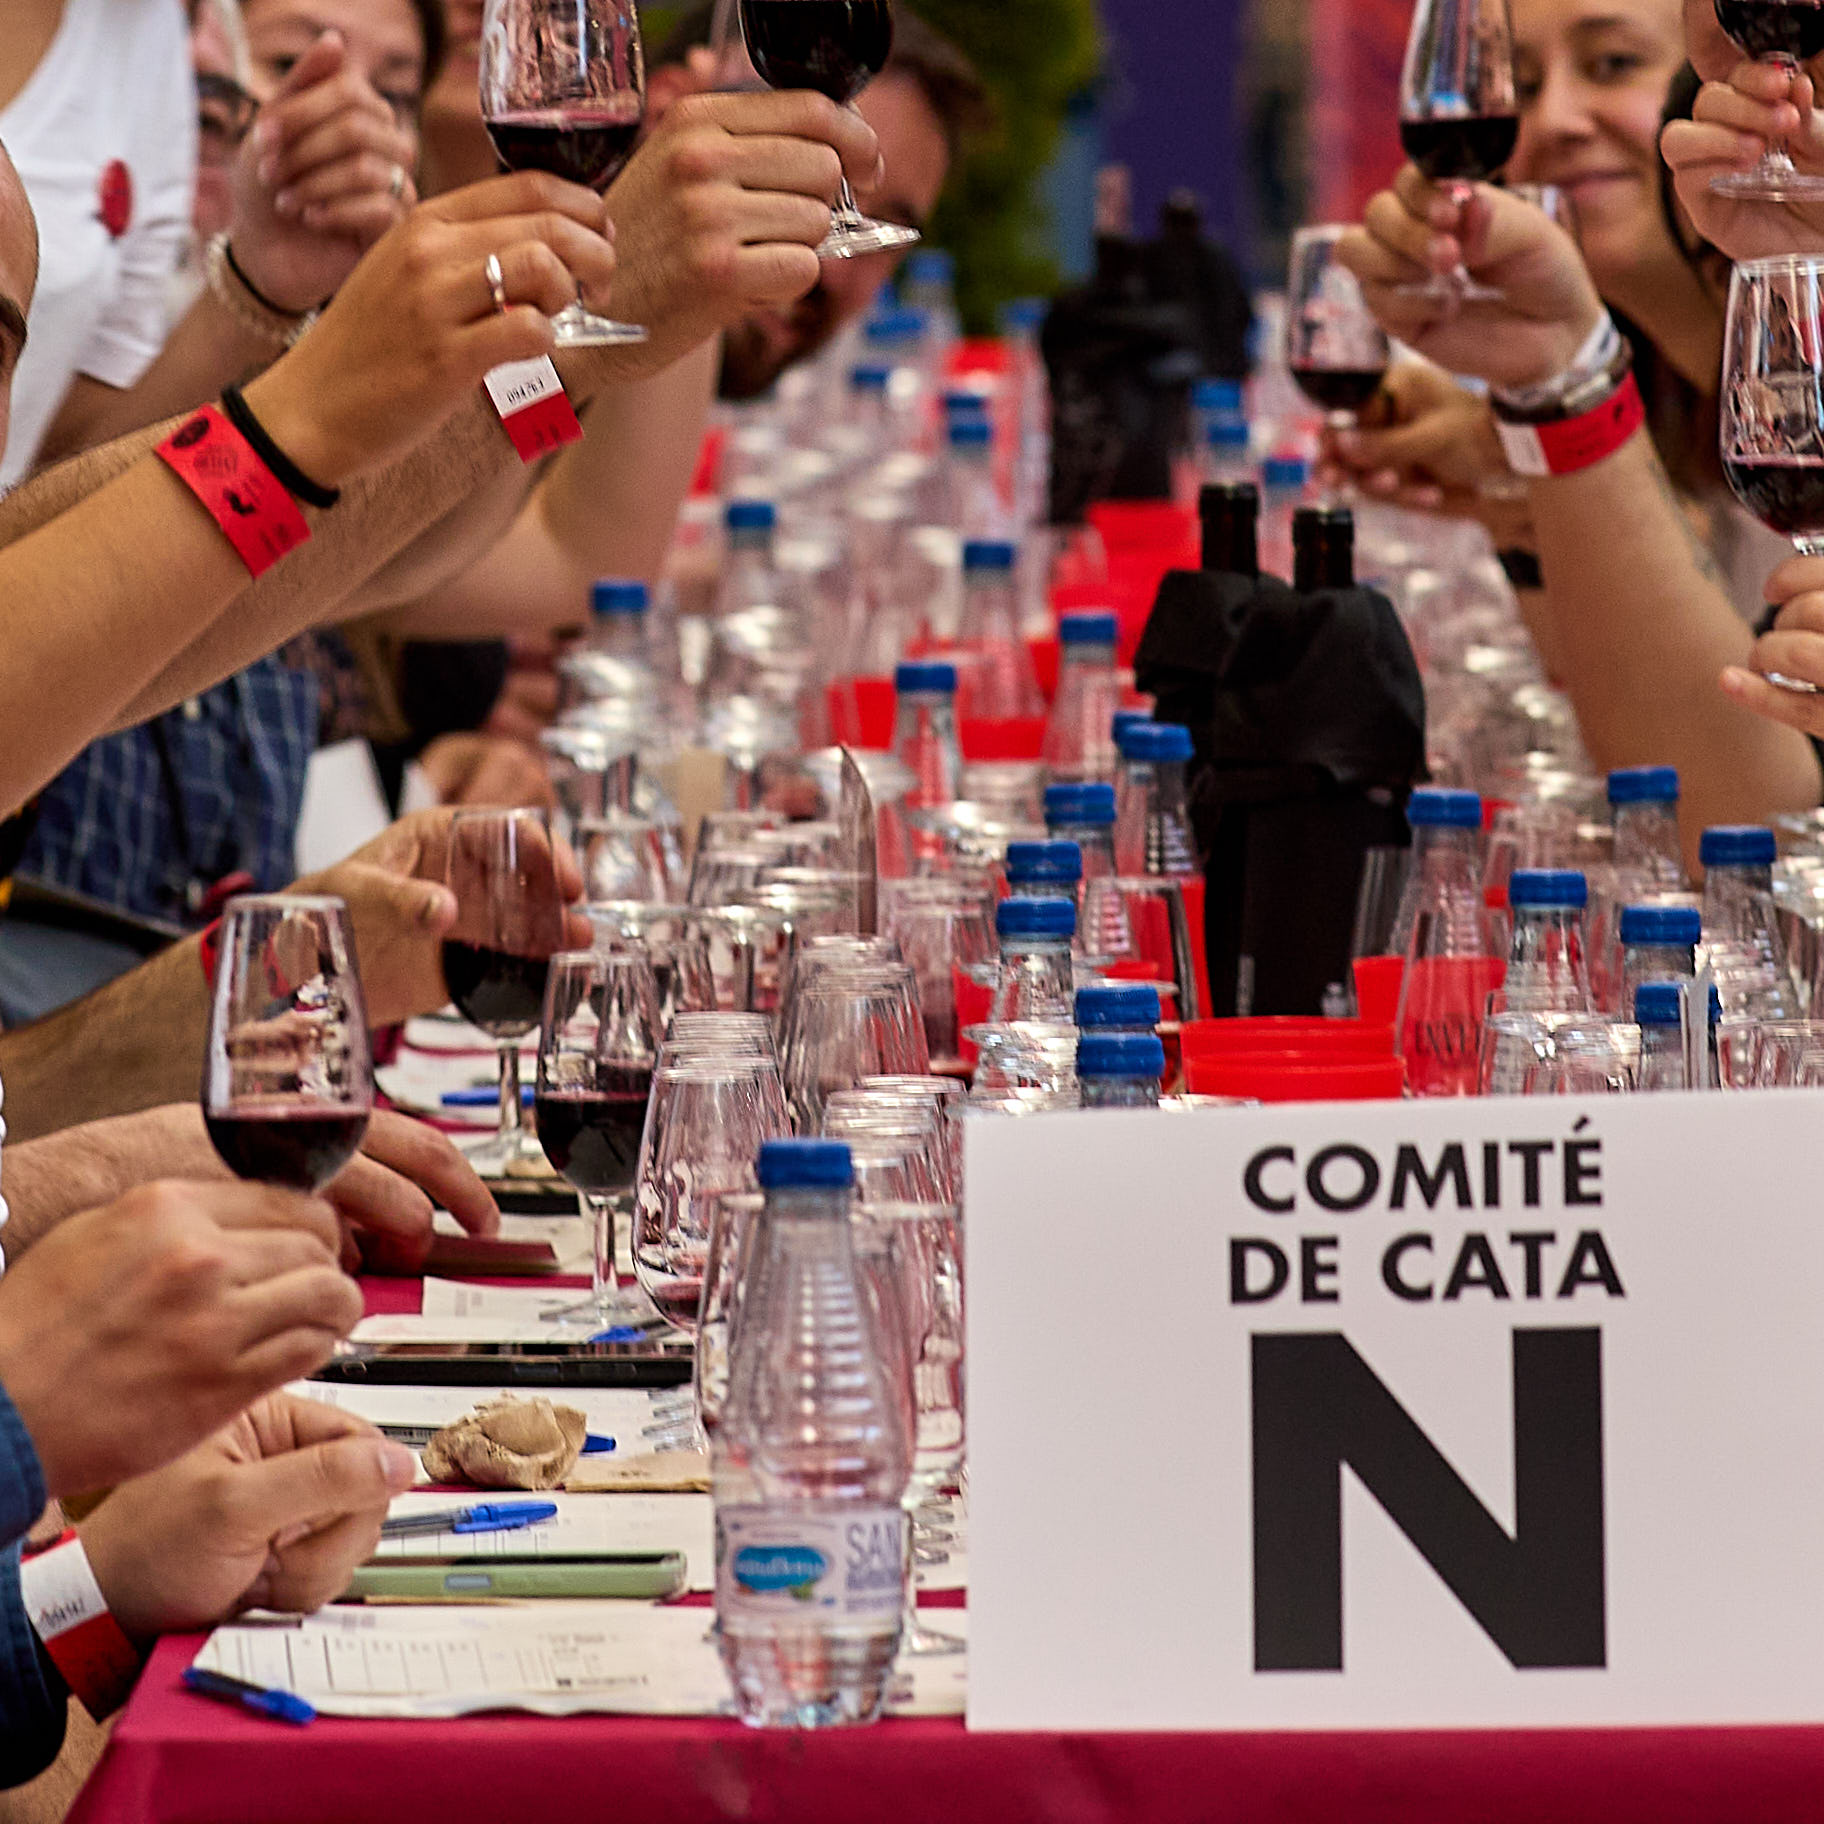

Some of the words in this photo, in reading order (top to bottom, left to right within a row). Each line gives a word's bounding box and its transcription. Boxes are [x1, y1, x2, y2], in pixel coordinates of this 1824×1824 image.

[1242, 1116, 1604, 1214] COMITÉ
[1229, 1236, 1340, 1306] DE
[1380, 1229, 1626, 1302] CATA
[1250, 1326, 1608, 1673] N
